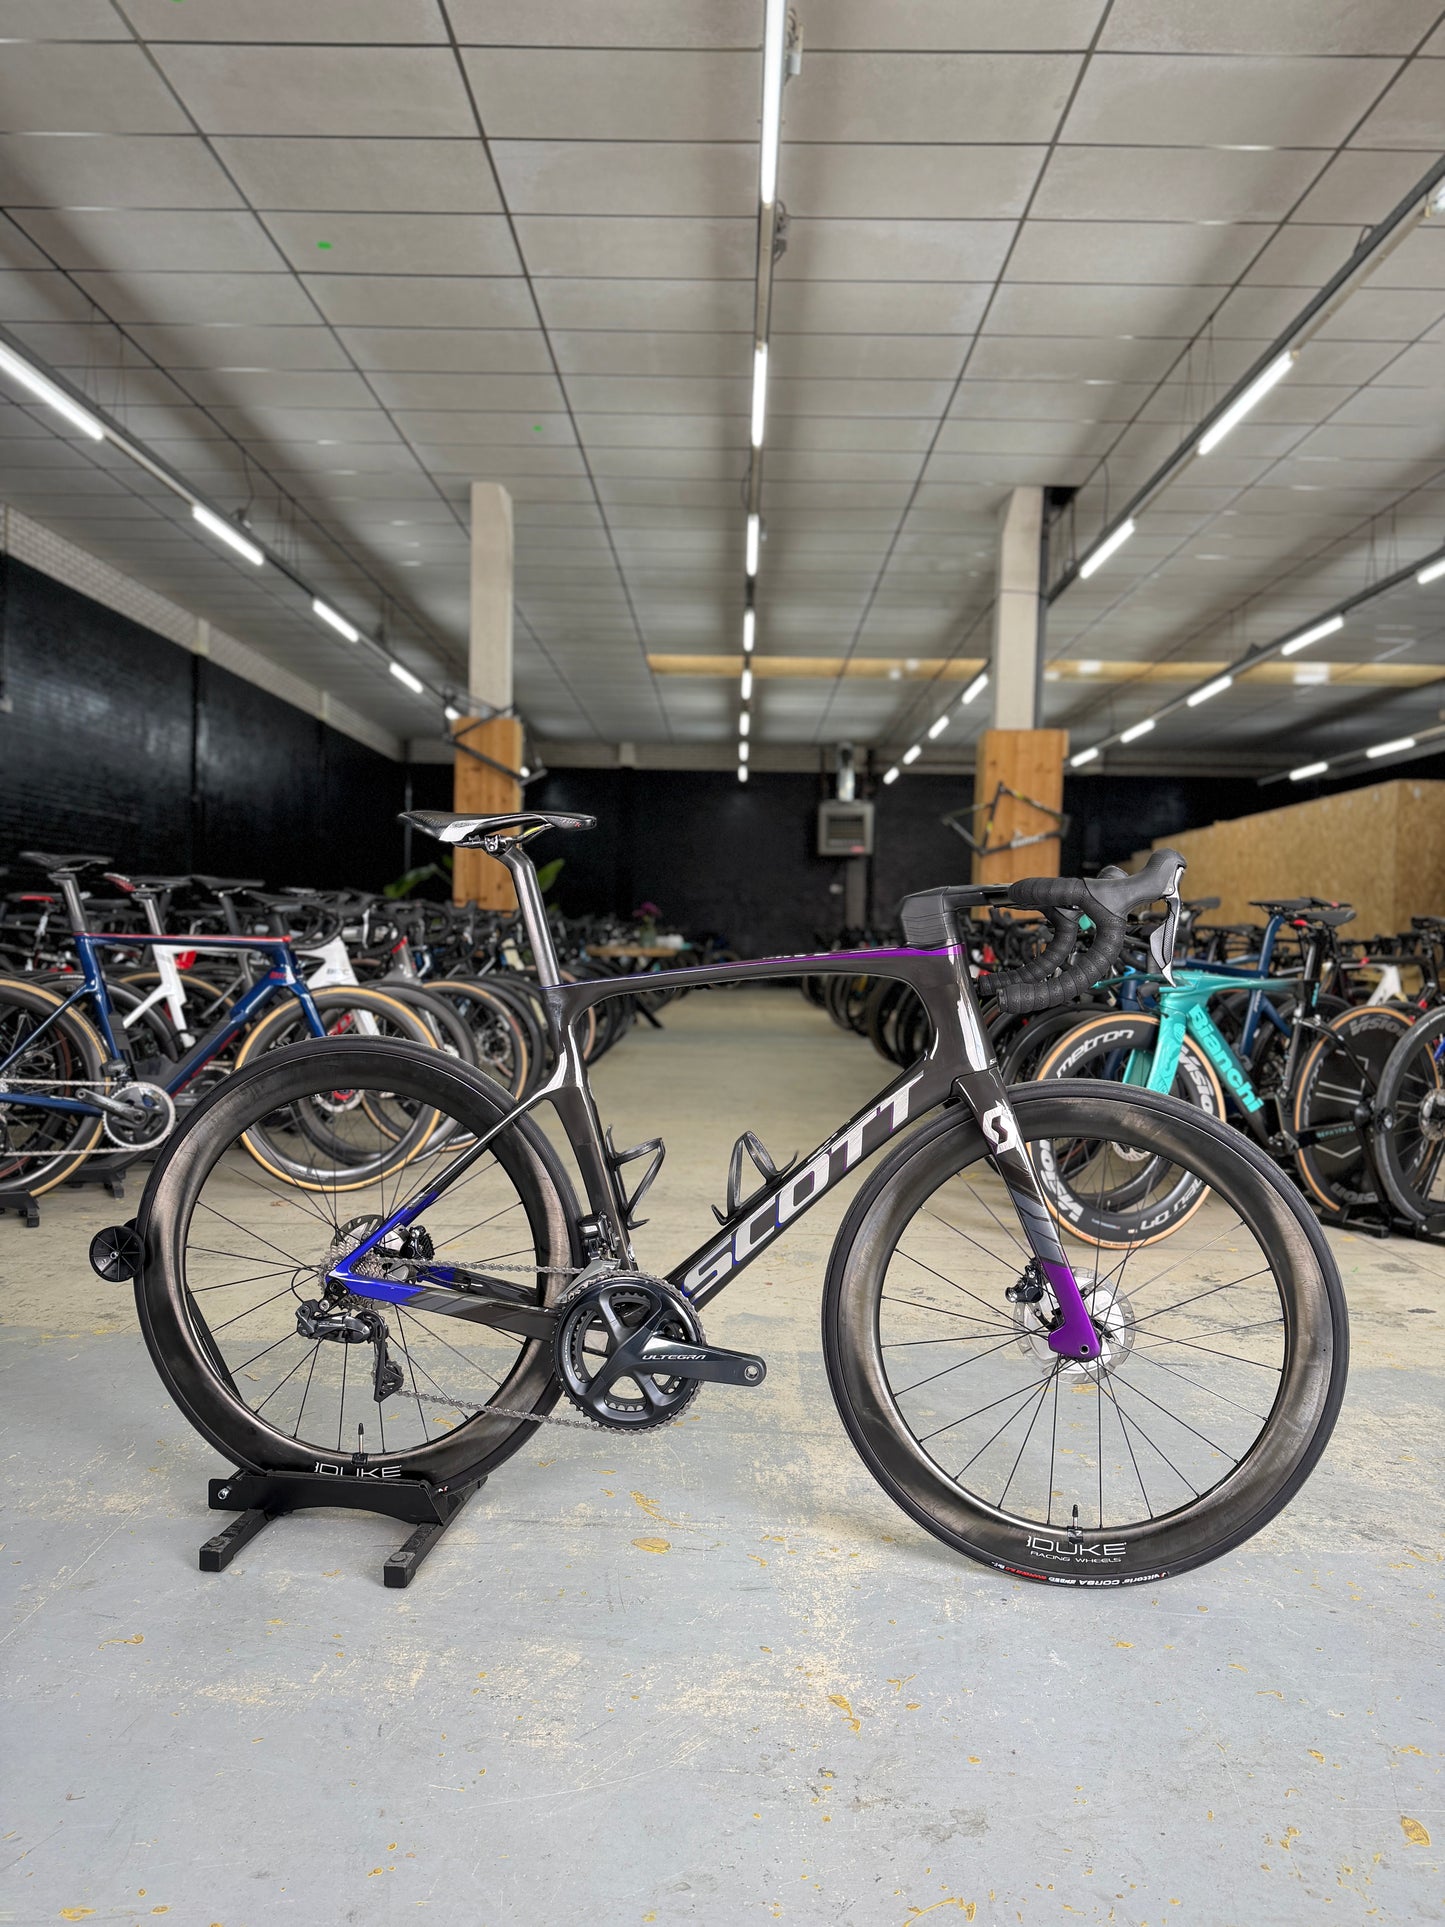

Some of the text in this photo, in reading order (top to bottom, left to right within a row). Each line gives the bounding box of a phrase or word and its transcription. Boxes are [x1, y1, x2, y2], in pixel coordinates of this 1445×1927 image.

[1056, 1029, 1134, 1079] metron
[1189, 1003, 1264, 1113] Bianchi
[681, 1070, 924, 1302] SCOTT
[1030, 1550, 1070, 1562] RACING
